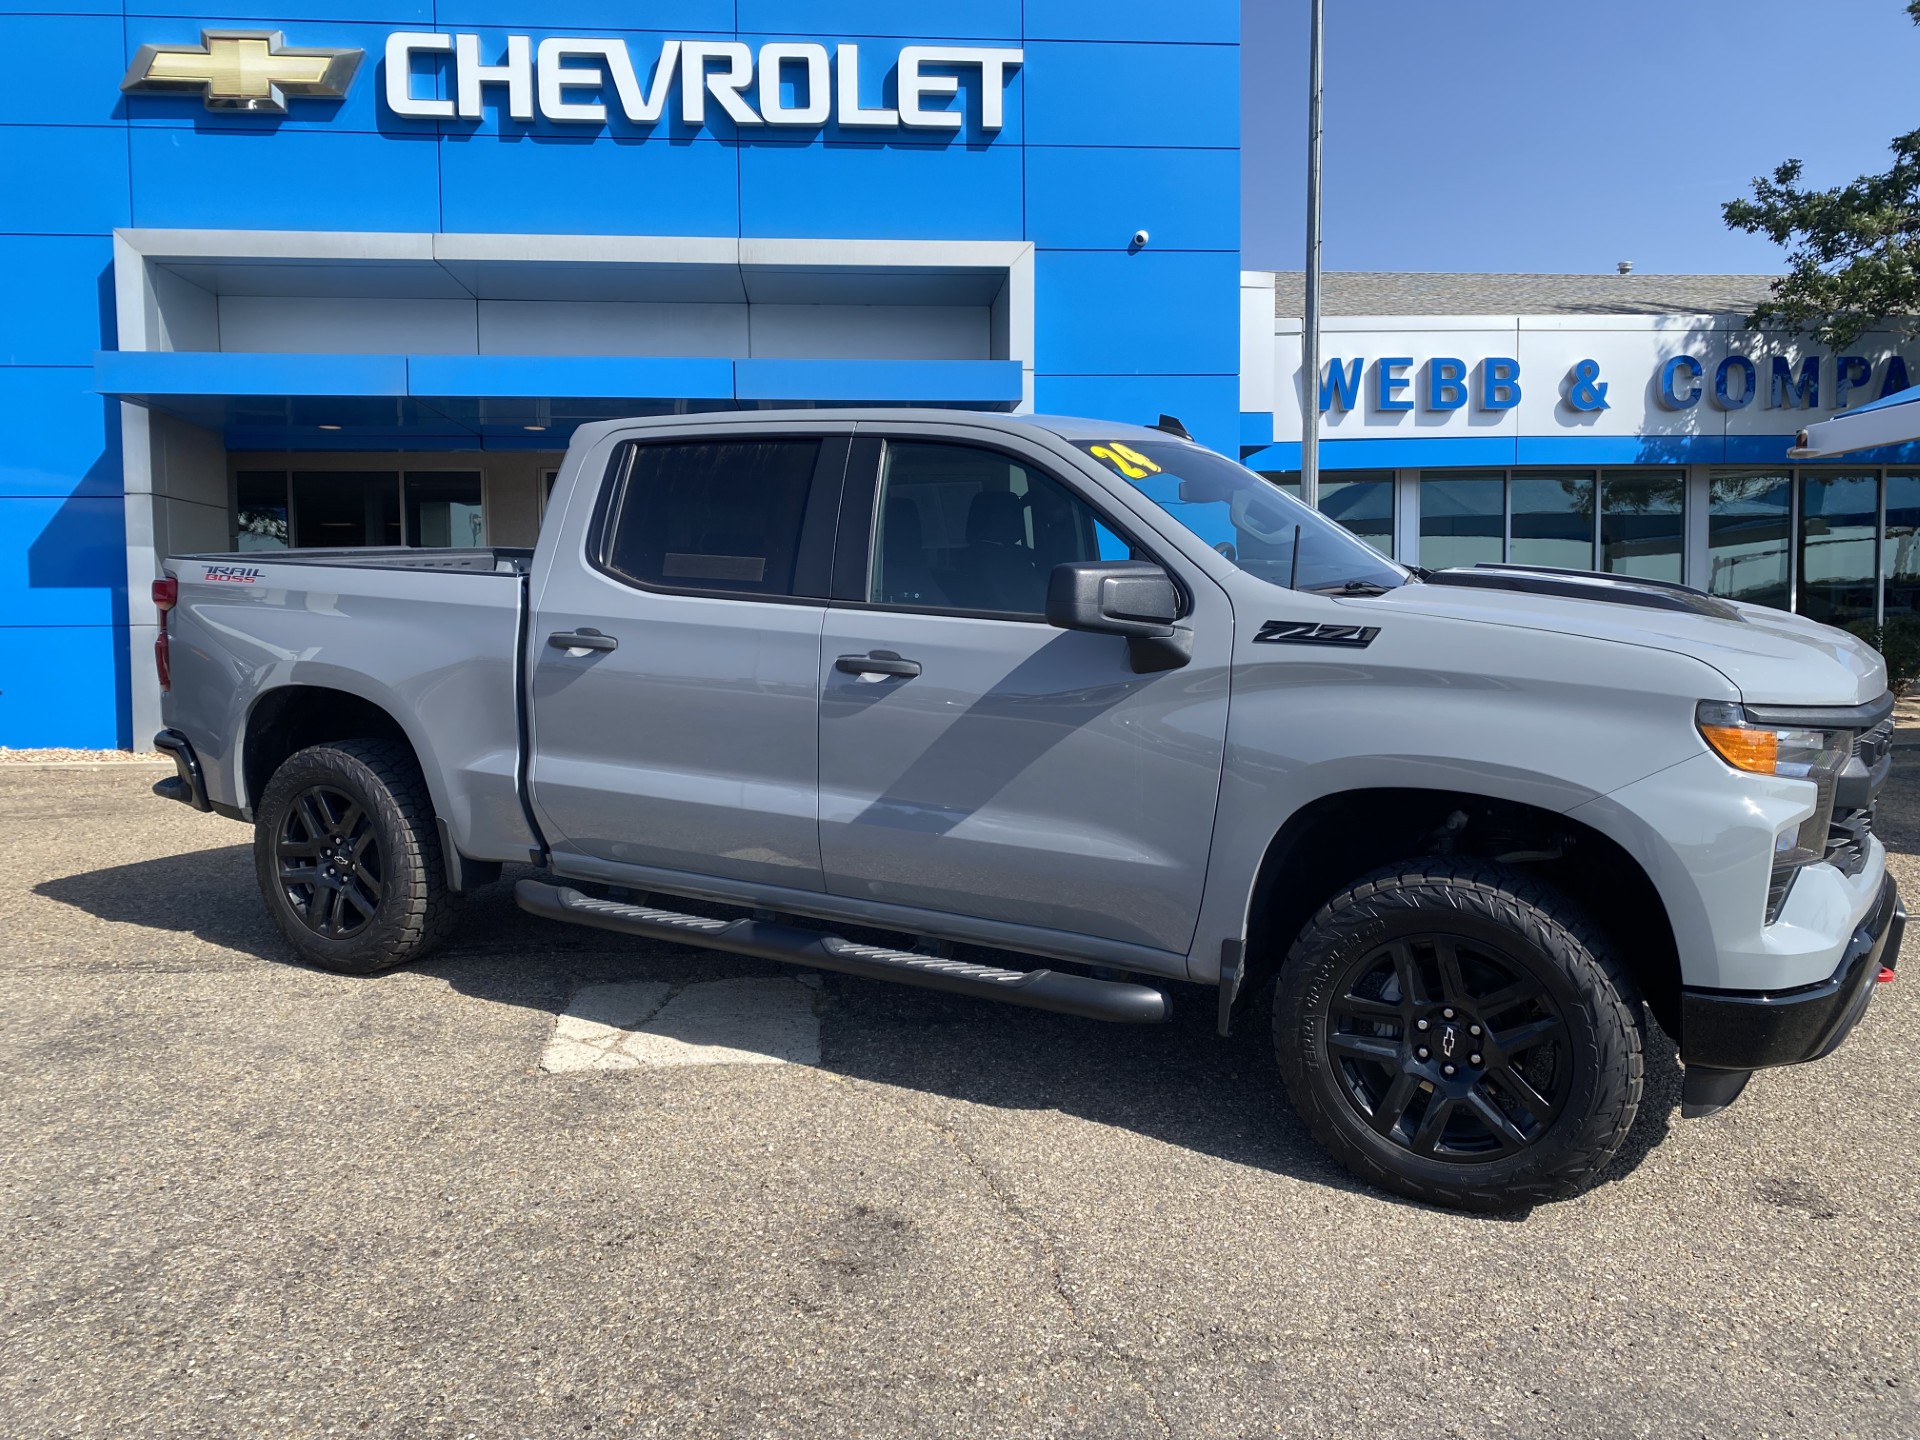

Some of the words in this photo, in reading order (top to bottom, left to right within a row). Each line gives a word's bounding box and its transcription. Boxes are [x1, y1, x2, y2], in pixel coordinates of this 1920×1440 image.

[384, 31, 1024, 133] CHEVROLET
[1319, 356, 1523, 411] WEBB
[1571, 358, 1611, 411] &
[1089, 442, 1162, 479] 24
[201, 565, 266, 578] TRAIL
[204, 573, 257, 584] BOSS
[1252, 619, 1382, 649] Z71
